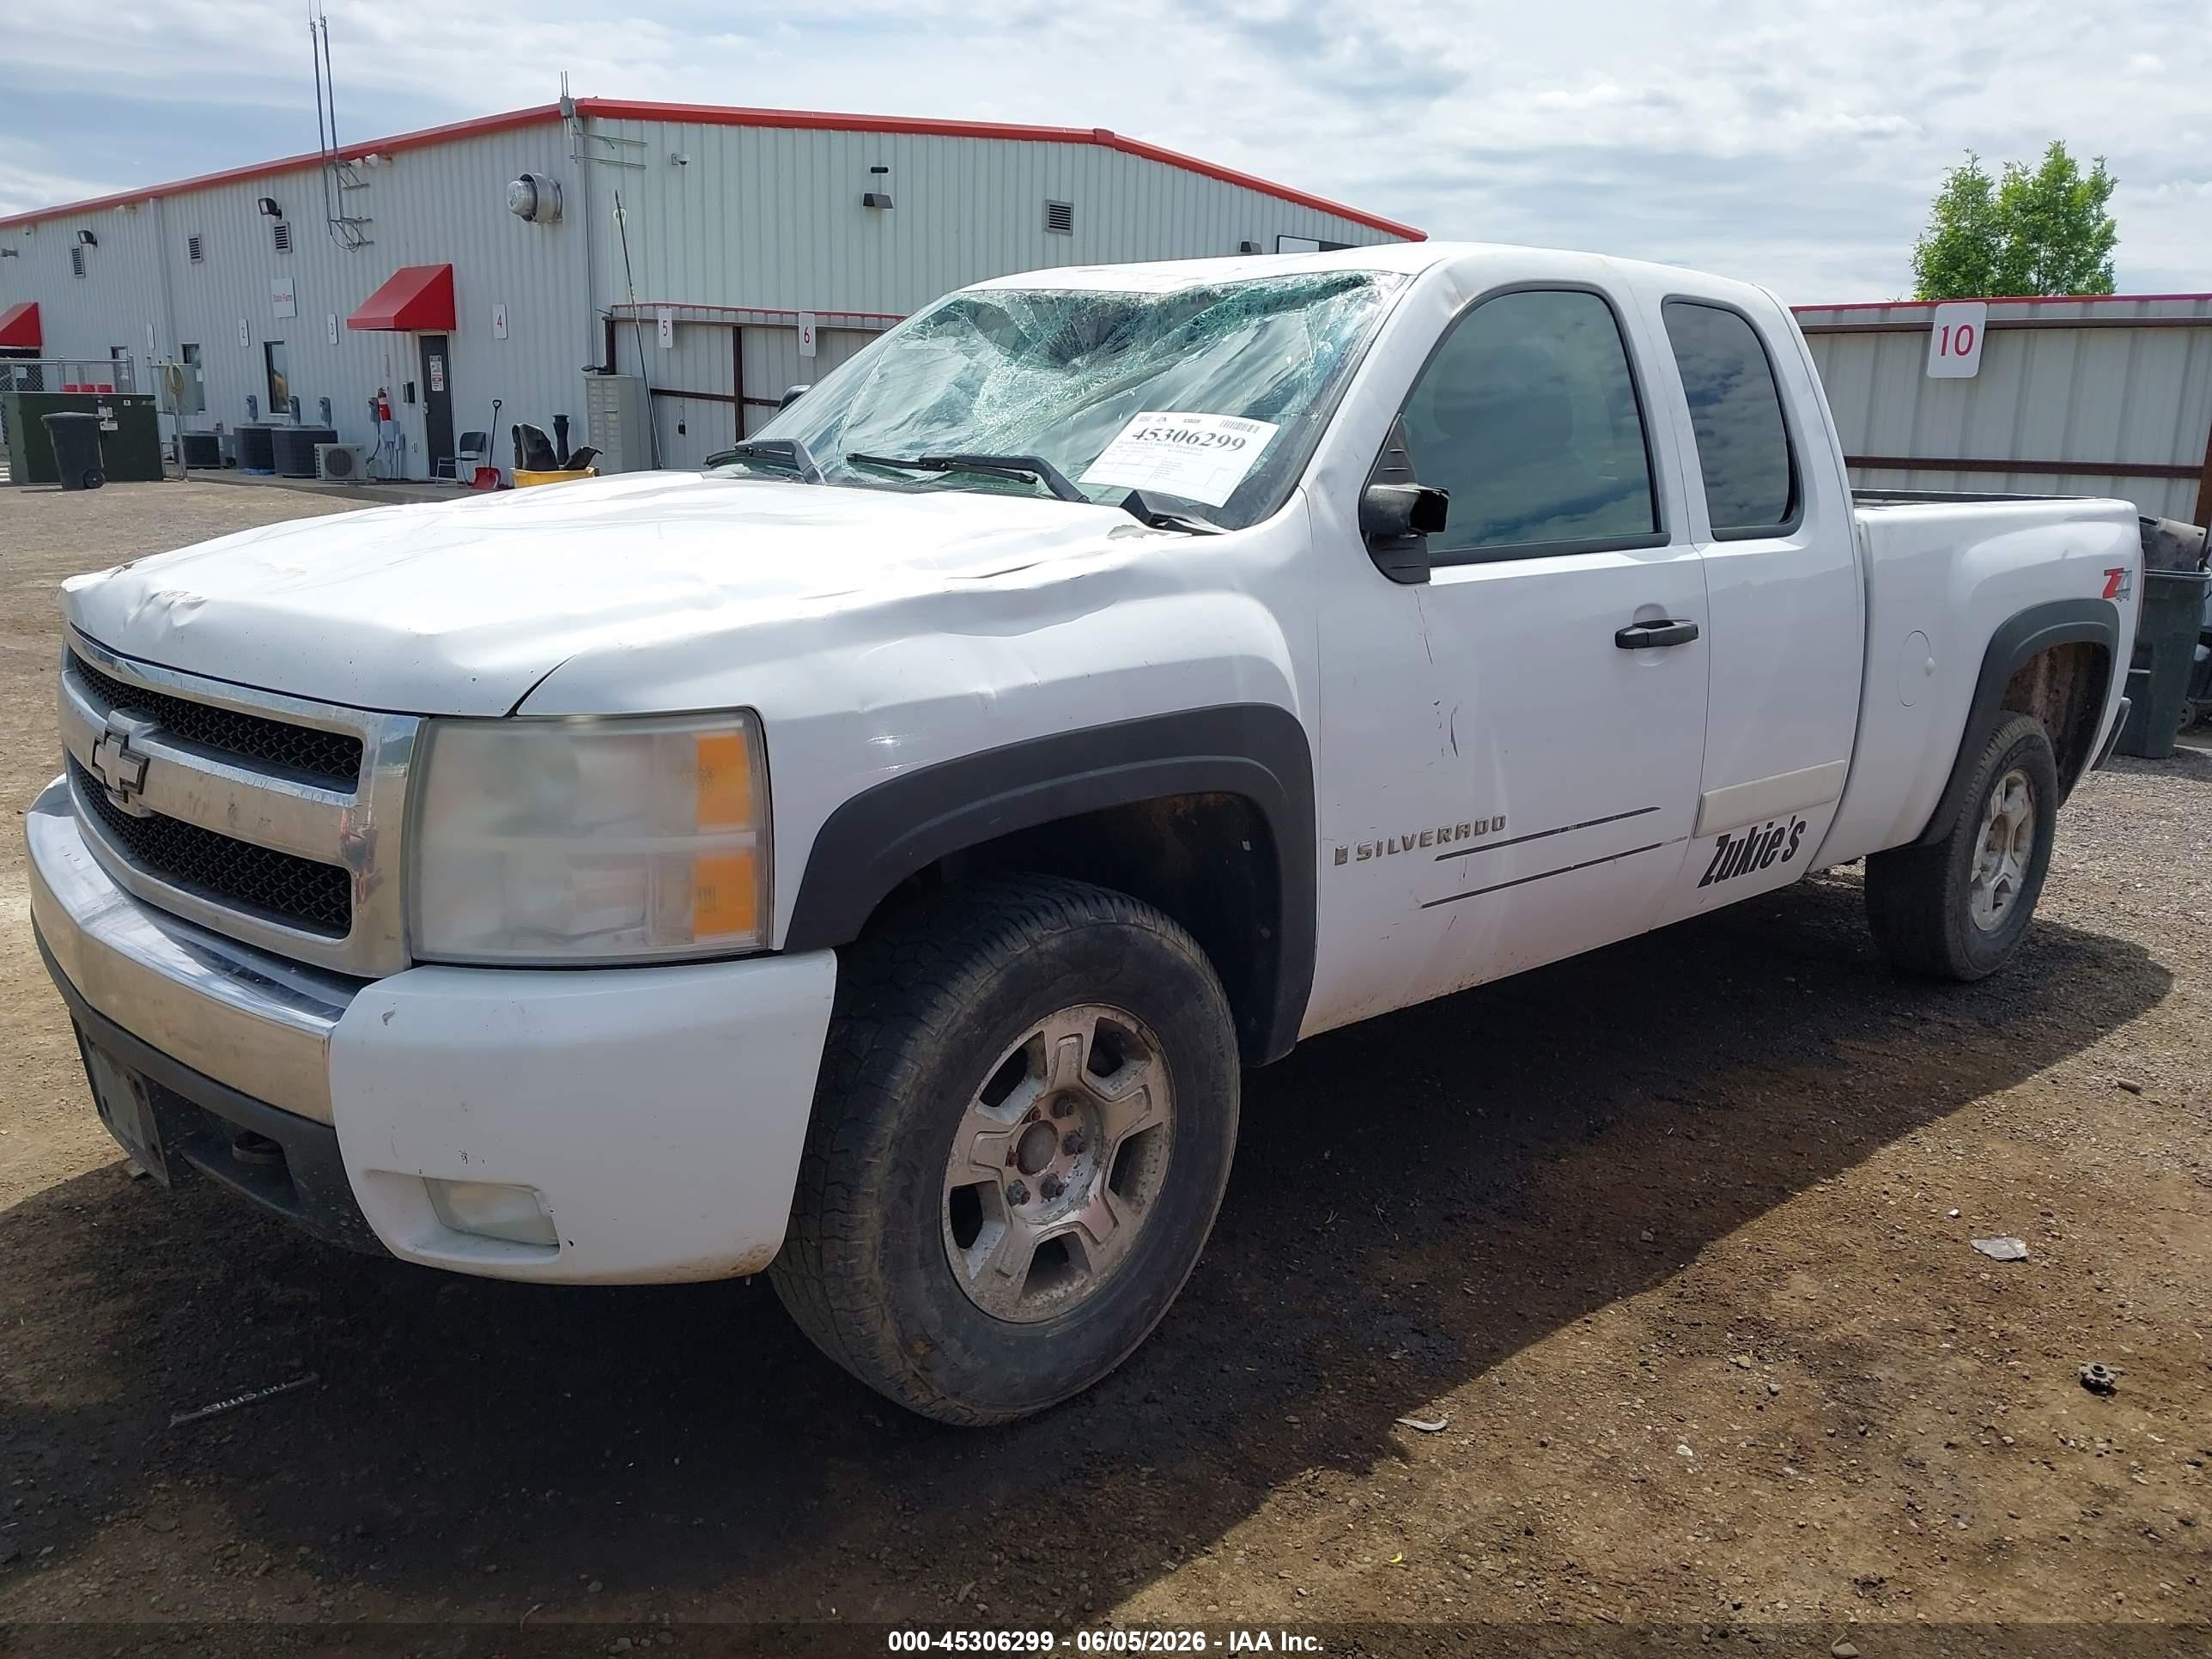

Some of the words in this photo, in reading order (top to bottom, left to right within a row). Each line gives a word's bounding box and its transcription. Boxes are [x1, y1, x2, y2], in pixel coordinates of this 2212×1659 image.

[496, 313, 502, 329] 4
[662, 320, 668, 337] 5
[804, 326, 810, 343] 6
[1941, 325, 1974, 356] 10
[1132, 427, 1247, 452] 45306299
[1356, 815, 1506, 861] SILVERADO
[1697, 814, 1807, 889] Zukie's
